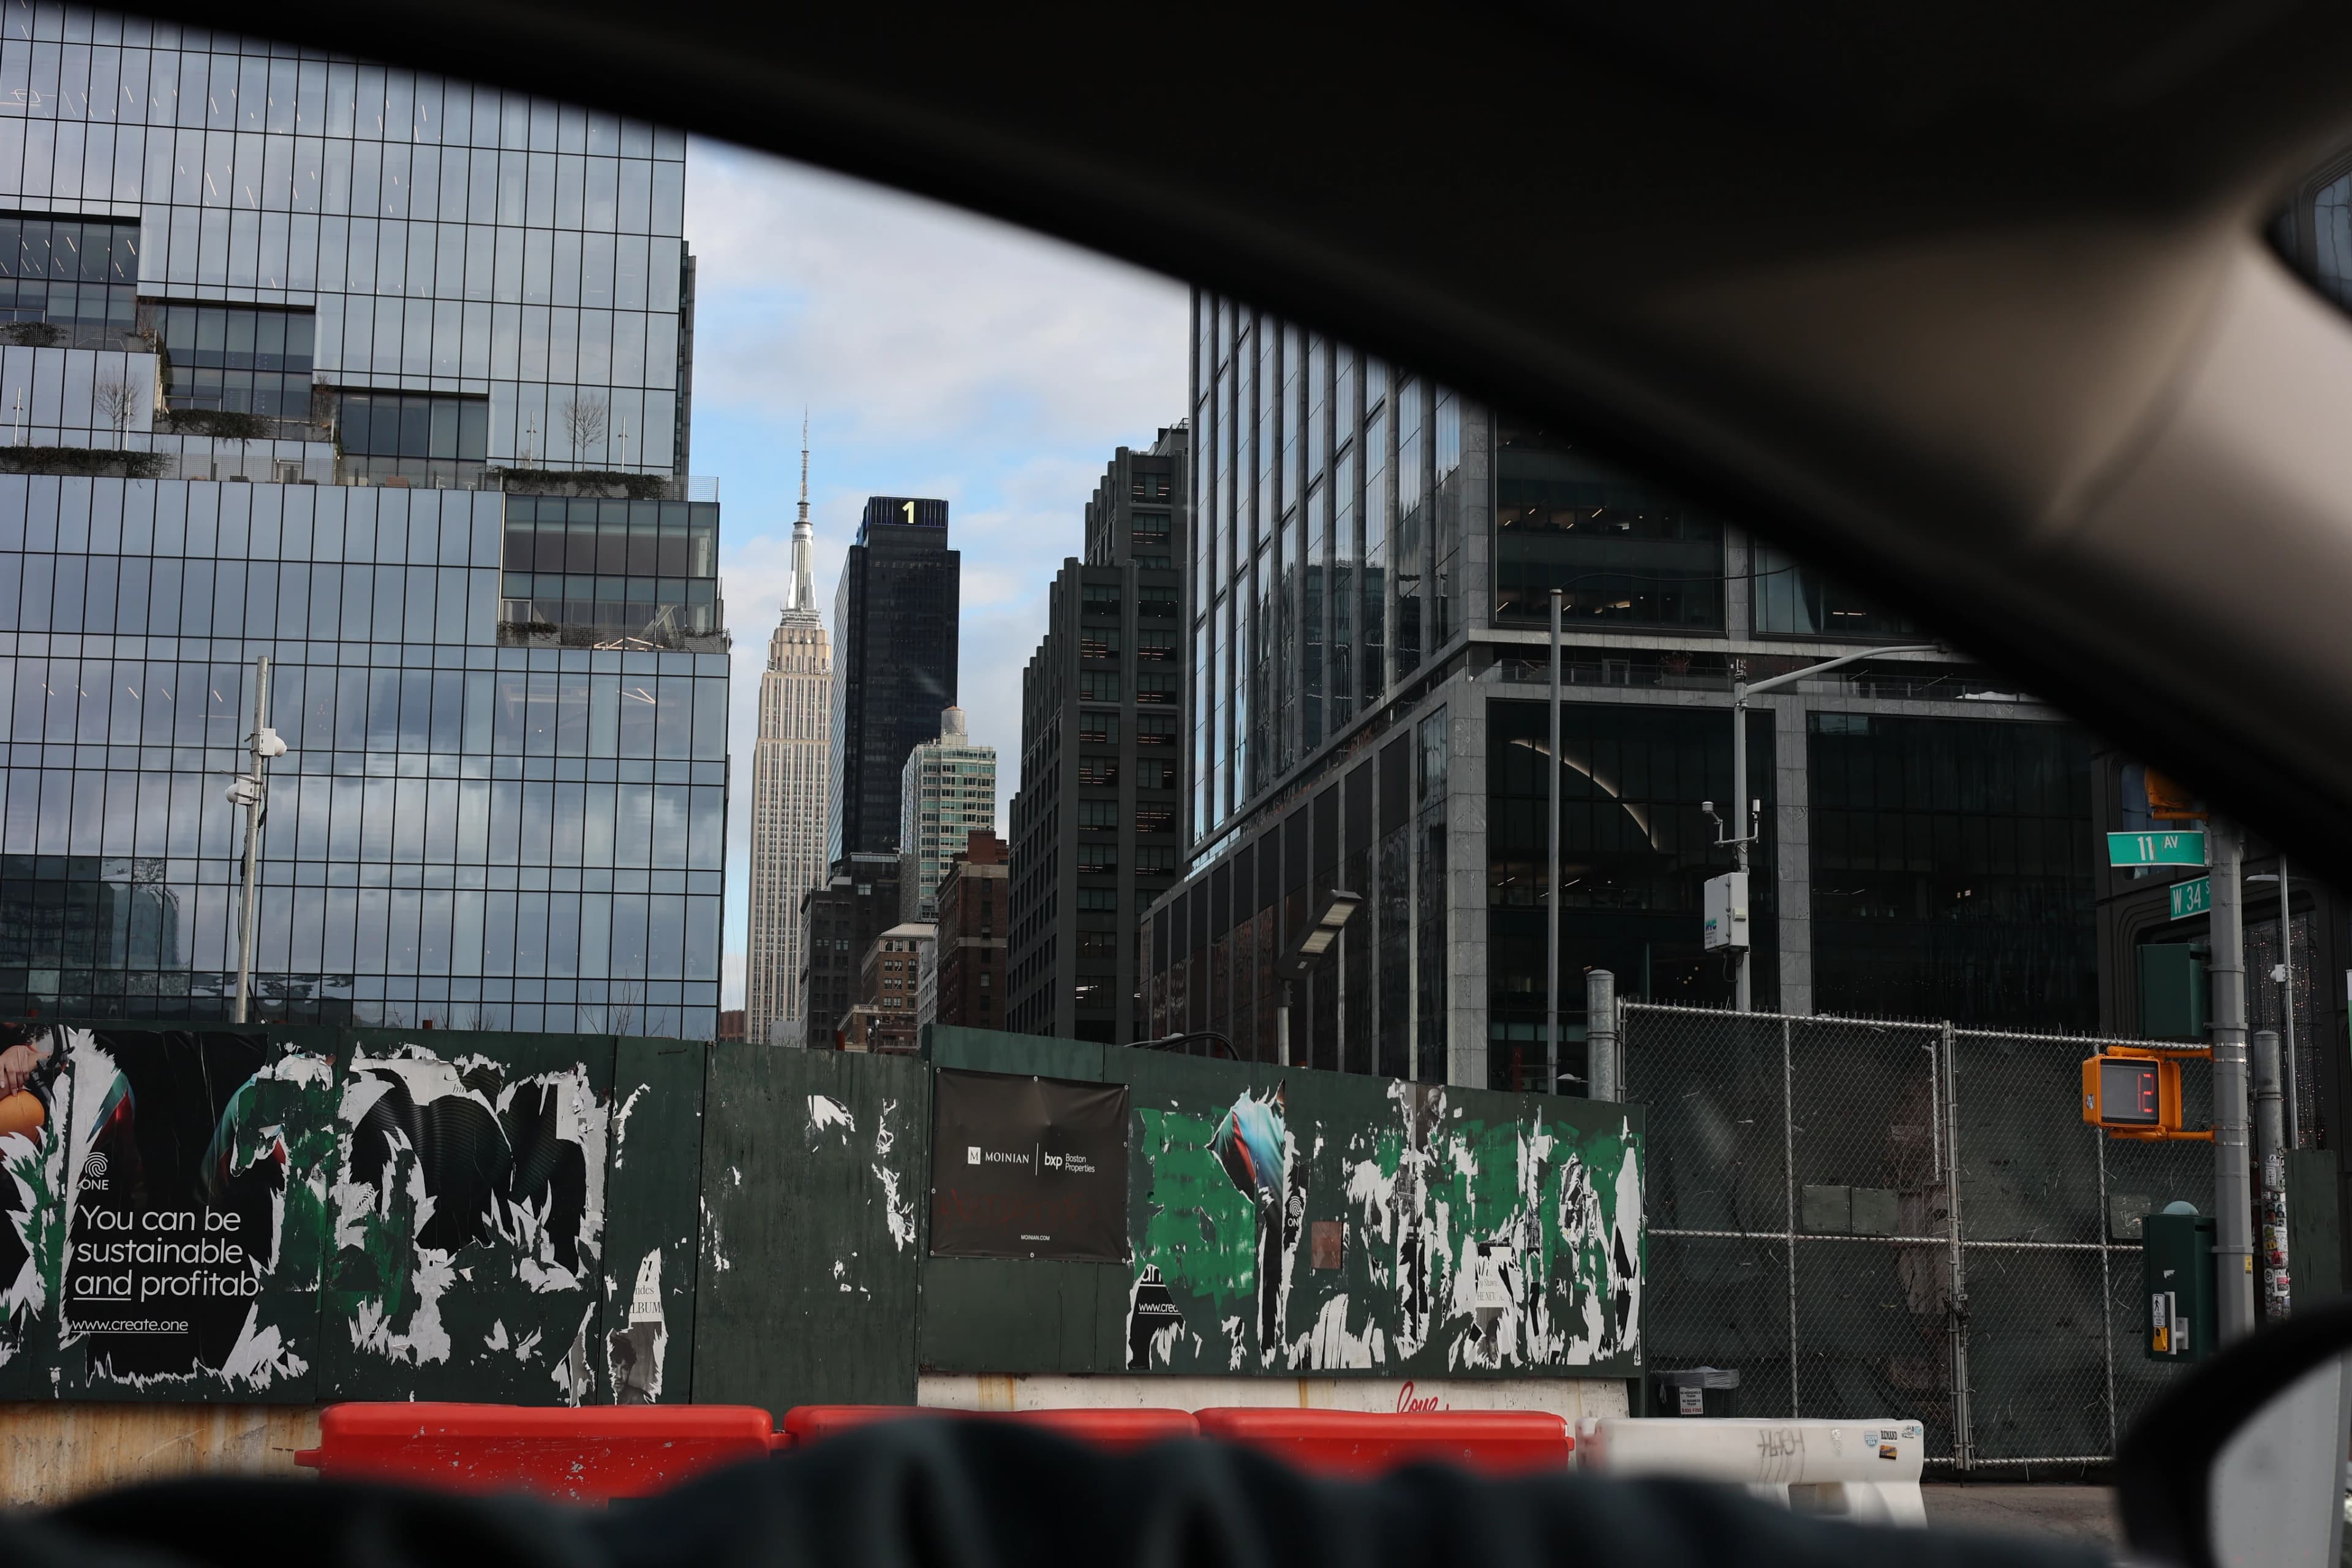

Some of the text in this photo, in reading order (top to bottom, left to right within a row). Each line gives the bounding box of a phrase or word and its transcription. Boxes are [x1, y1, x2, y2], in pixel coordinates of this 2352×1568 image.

[902, 501, 914, 524] 1
[2137, 835, 2178, 861] 11 AV
[2173, 888, 2182, 914] W
[2187, 883, 2201, 911] 34
[2138, 1073, 2154, 1112] 12
[986, 1152, 1029, 1164] MOINIAN
[1044, 1152, 1063, 1170] bxp
[1065, 1163, 1095, 1173] Properties
[1066, 1153, 1086, 1163] Boston
[81, 1179, 109, 1190] ONE
[80, 1205, 241, 1231] You can be
[77, 1237, 243, 1264] sustainable
[75, 1269, 132, 1295] and
[630, 1302, 662, 1313] LBUM
[72, 1319, 188, 1331] www.create.one
